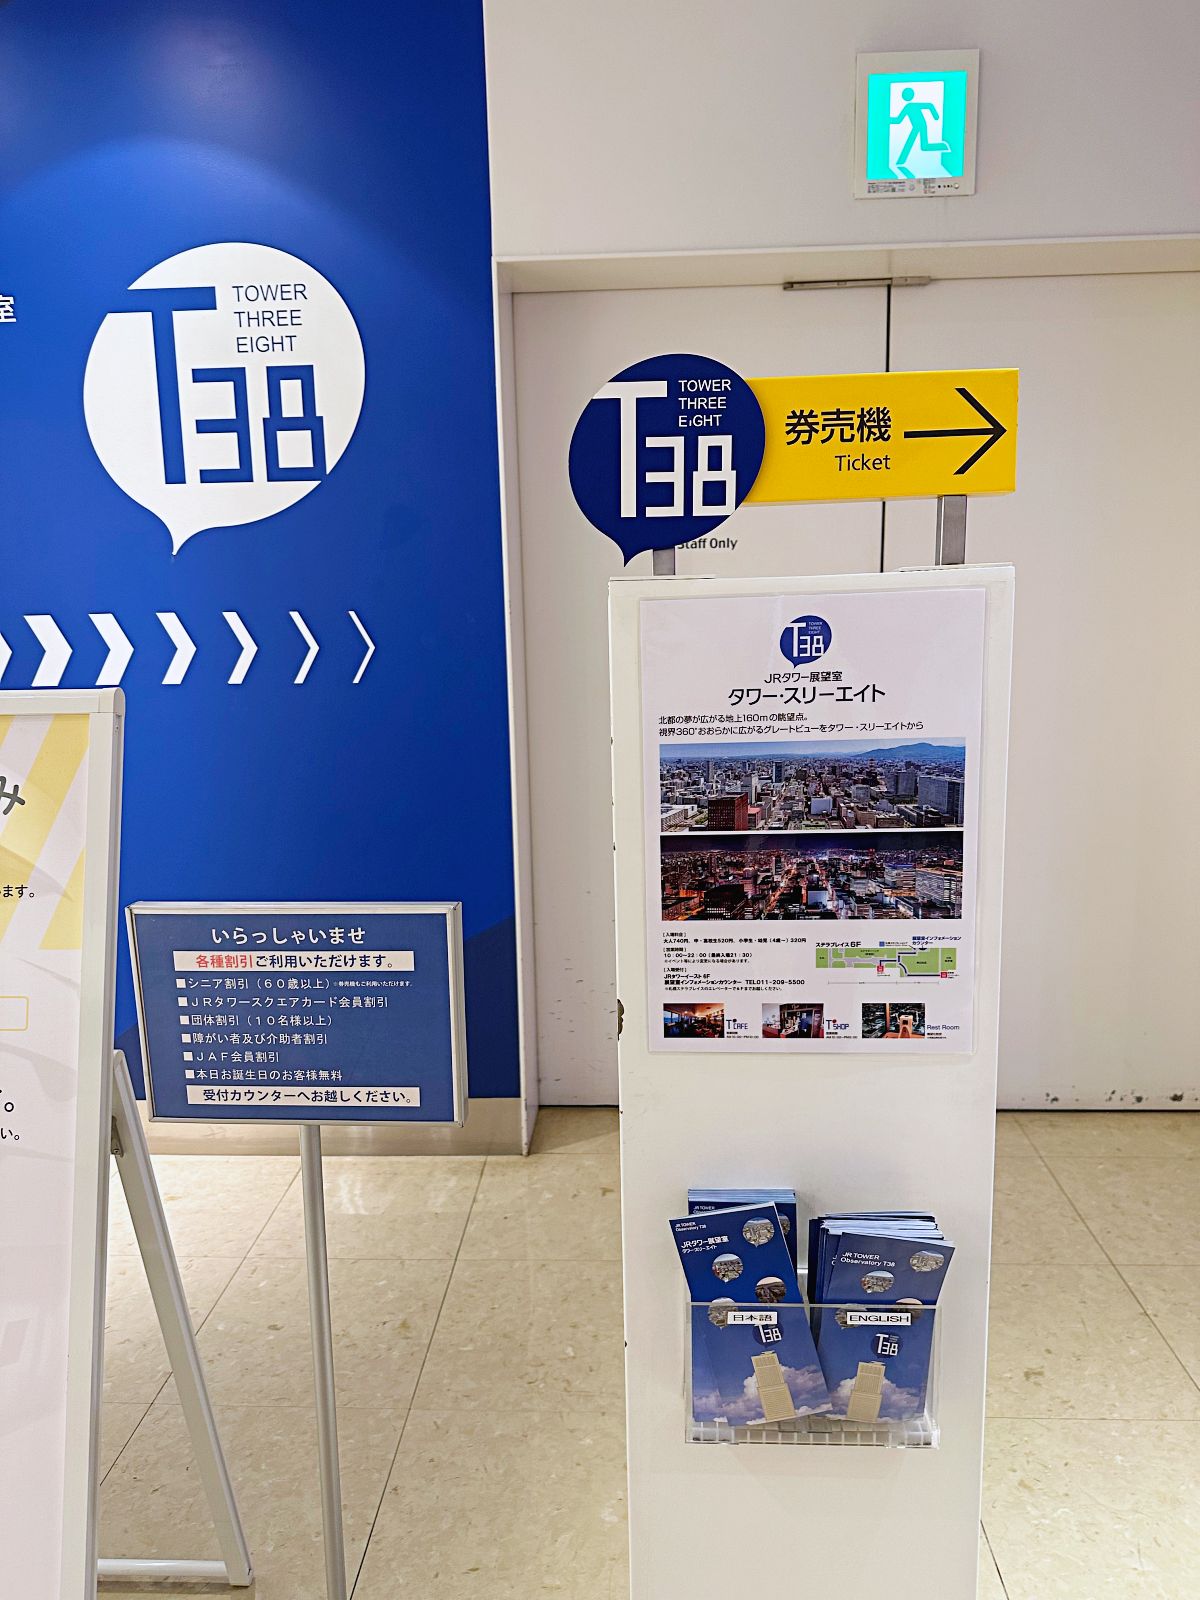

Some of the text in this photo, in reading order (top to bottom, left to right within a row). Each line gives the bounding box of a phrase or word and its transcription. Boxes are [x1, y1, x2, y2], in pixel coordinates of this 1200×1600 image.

[232, 283, 308, 303] TOWER
[234, 309, 303, 328] THREE
[236, 335, 297, 353] EIGHT
[678, 379, 732, 392] TOWER
[678, 397, 727, 410] THREE
[785, 407, 892, 447] 券売機
[835, 454, 891, 472] Ticket
[709, 537, 738, 551] Only
[764, 671, 843, 684] JRタワー展望室
[728, 684, 886, 707] タワー・スリーエイト
[0, 884, 35, 899] ます。
[211, 927, 366, 946] いらっしゃいませ
[195, 954, 394, 970] 各種割引ご利用いただけます。
[191, 996, 389, 1009] JRタワースクエアカード会員割引
[192, 1031, 328, 1046] 障がい者及び介助者割引
[196, 1050, 280, 1064] JAF会員割引
[196, 1068, 343, 1082] 本日お誕生日のお客様無料
[203, 1088, 412, 1105] 受付カウンターへお越しください。
[840, 1256, 882, 1267] Observatory
[853, 1252, 880, 1260] TOWER
[733, 1314, 773, 1323] 日本語
[849, 1314, 910, 1324] ENGLISH
